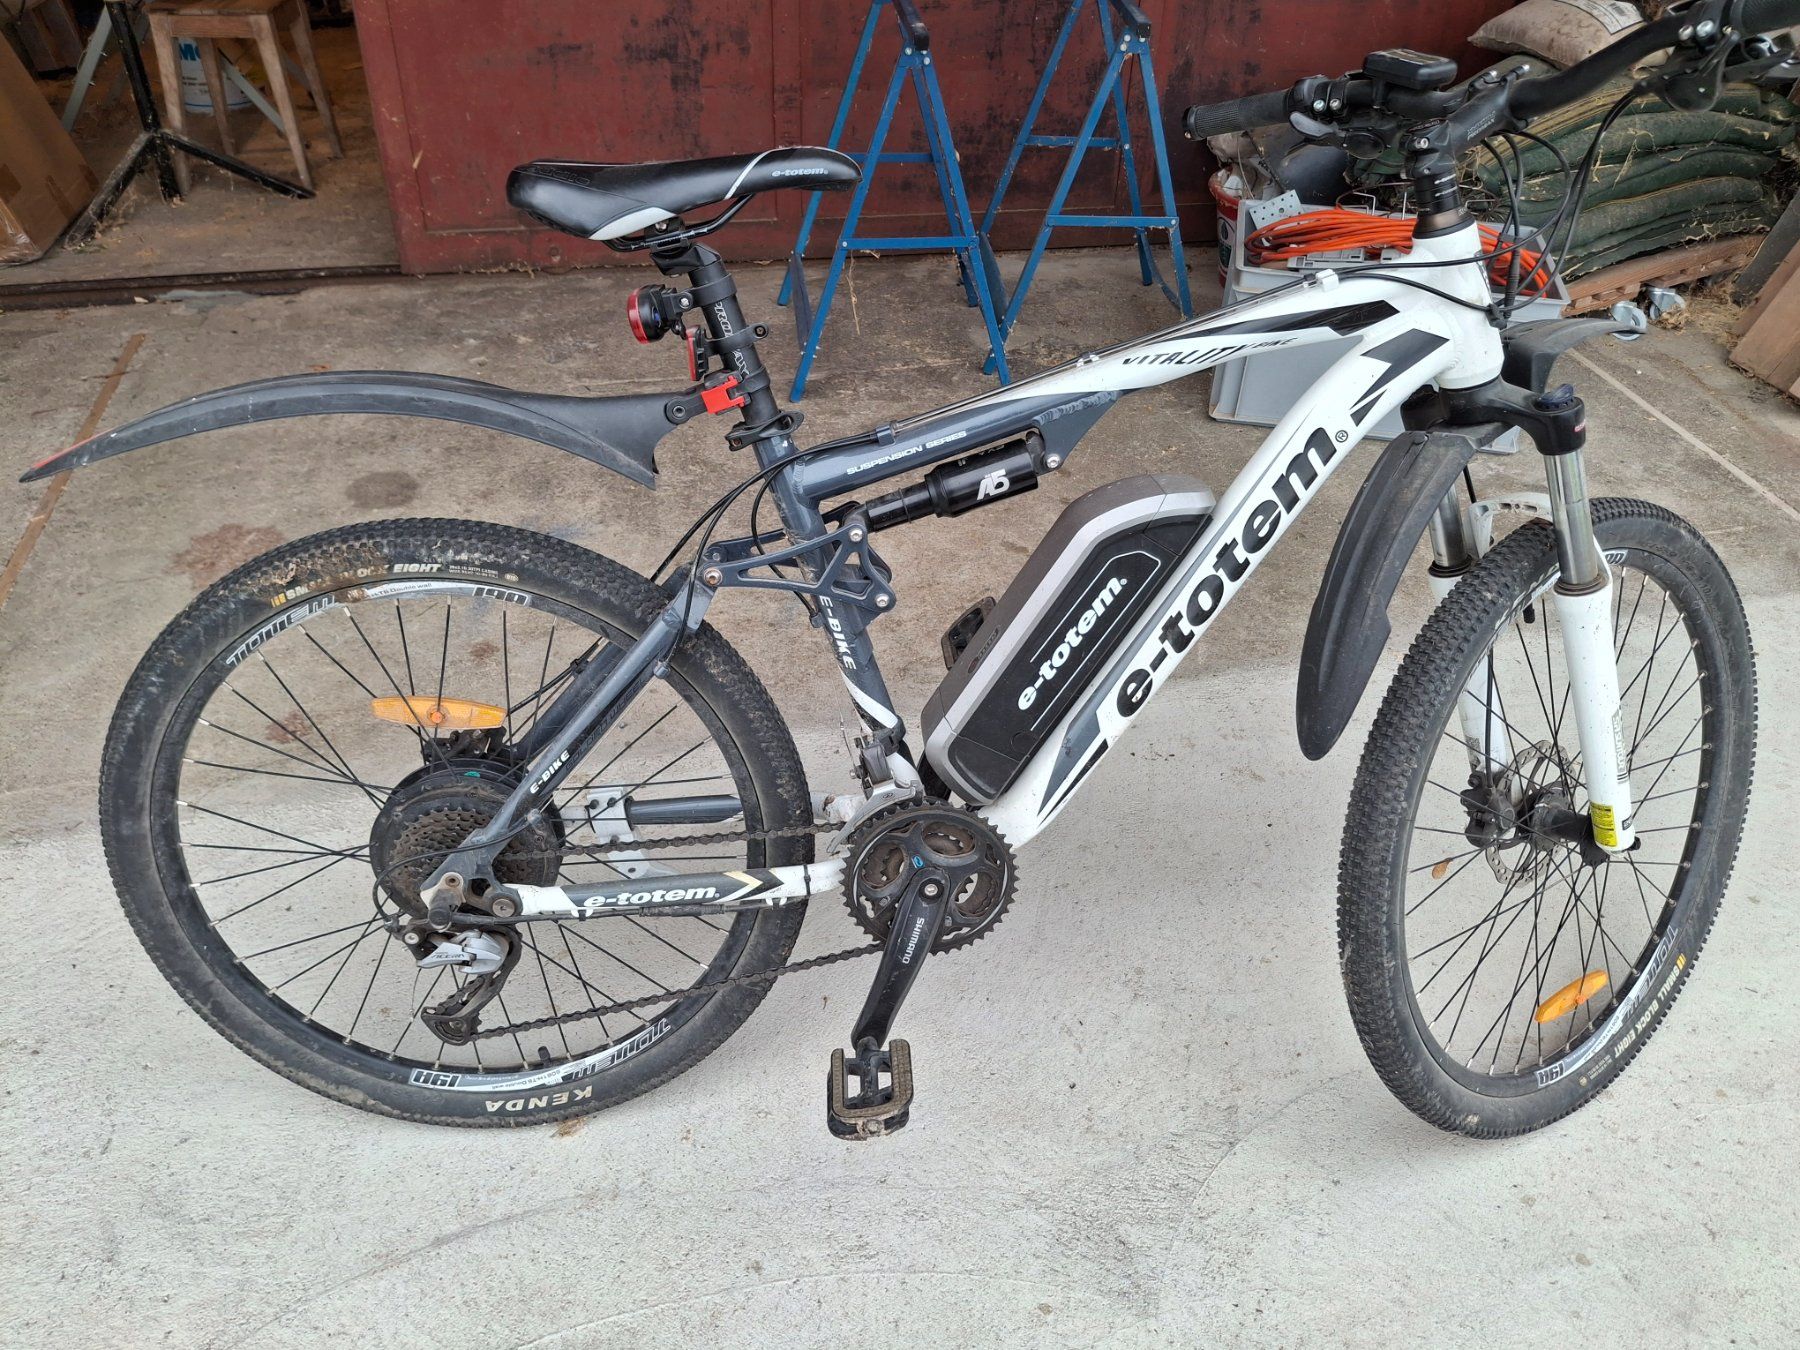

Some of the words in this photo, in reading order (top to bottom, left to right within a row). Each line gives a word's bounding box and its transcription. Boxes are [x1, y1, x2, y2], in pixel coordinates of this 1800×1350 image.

[771, 168, 825, 177] e-totem
[1123, 344, 1248, 365] VITALITY
[846, 444, 923, 475] SUSPENSION
[925, 430, 967, 450] SERIES
[392, 563, 443, 573] EIGHT
[1117, 427, 1337, 718] e-totem
[820, 595, 857, 670] E-BIKE
[1018, 577, 1122, 711] e-totem
[529, 750, 570, 794] E-BIKE
[584, 886, 716, 907] e-totem
[902, 917, 925, 965] SHIMANO
[1657, 966, 1682, 999] SMALL
[1634, 1003, 1660, 1035] BLOCK
[1614, 1028, 1637, 1058] EIGHT
[485, 1085, 593, 1113] KENDA
